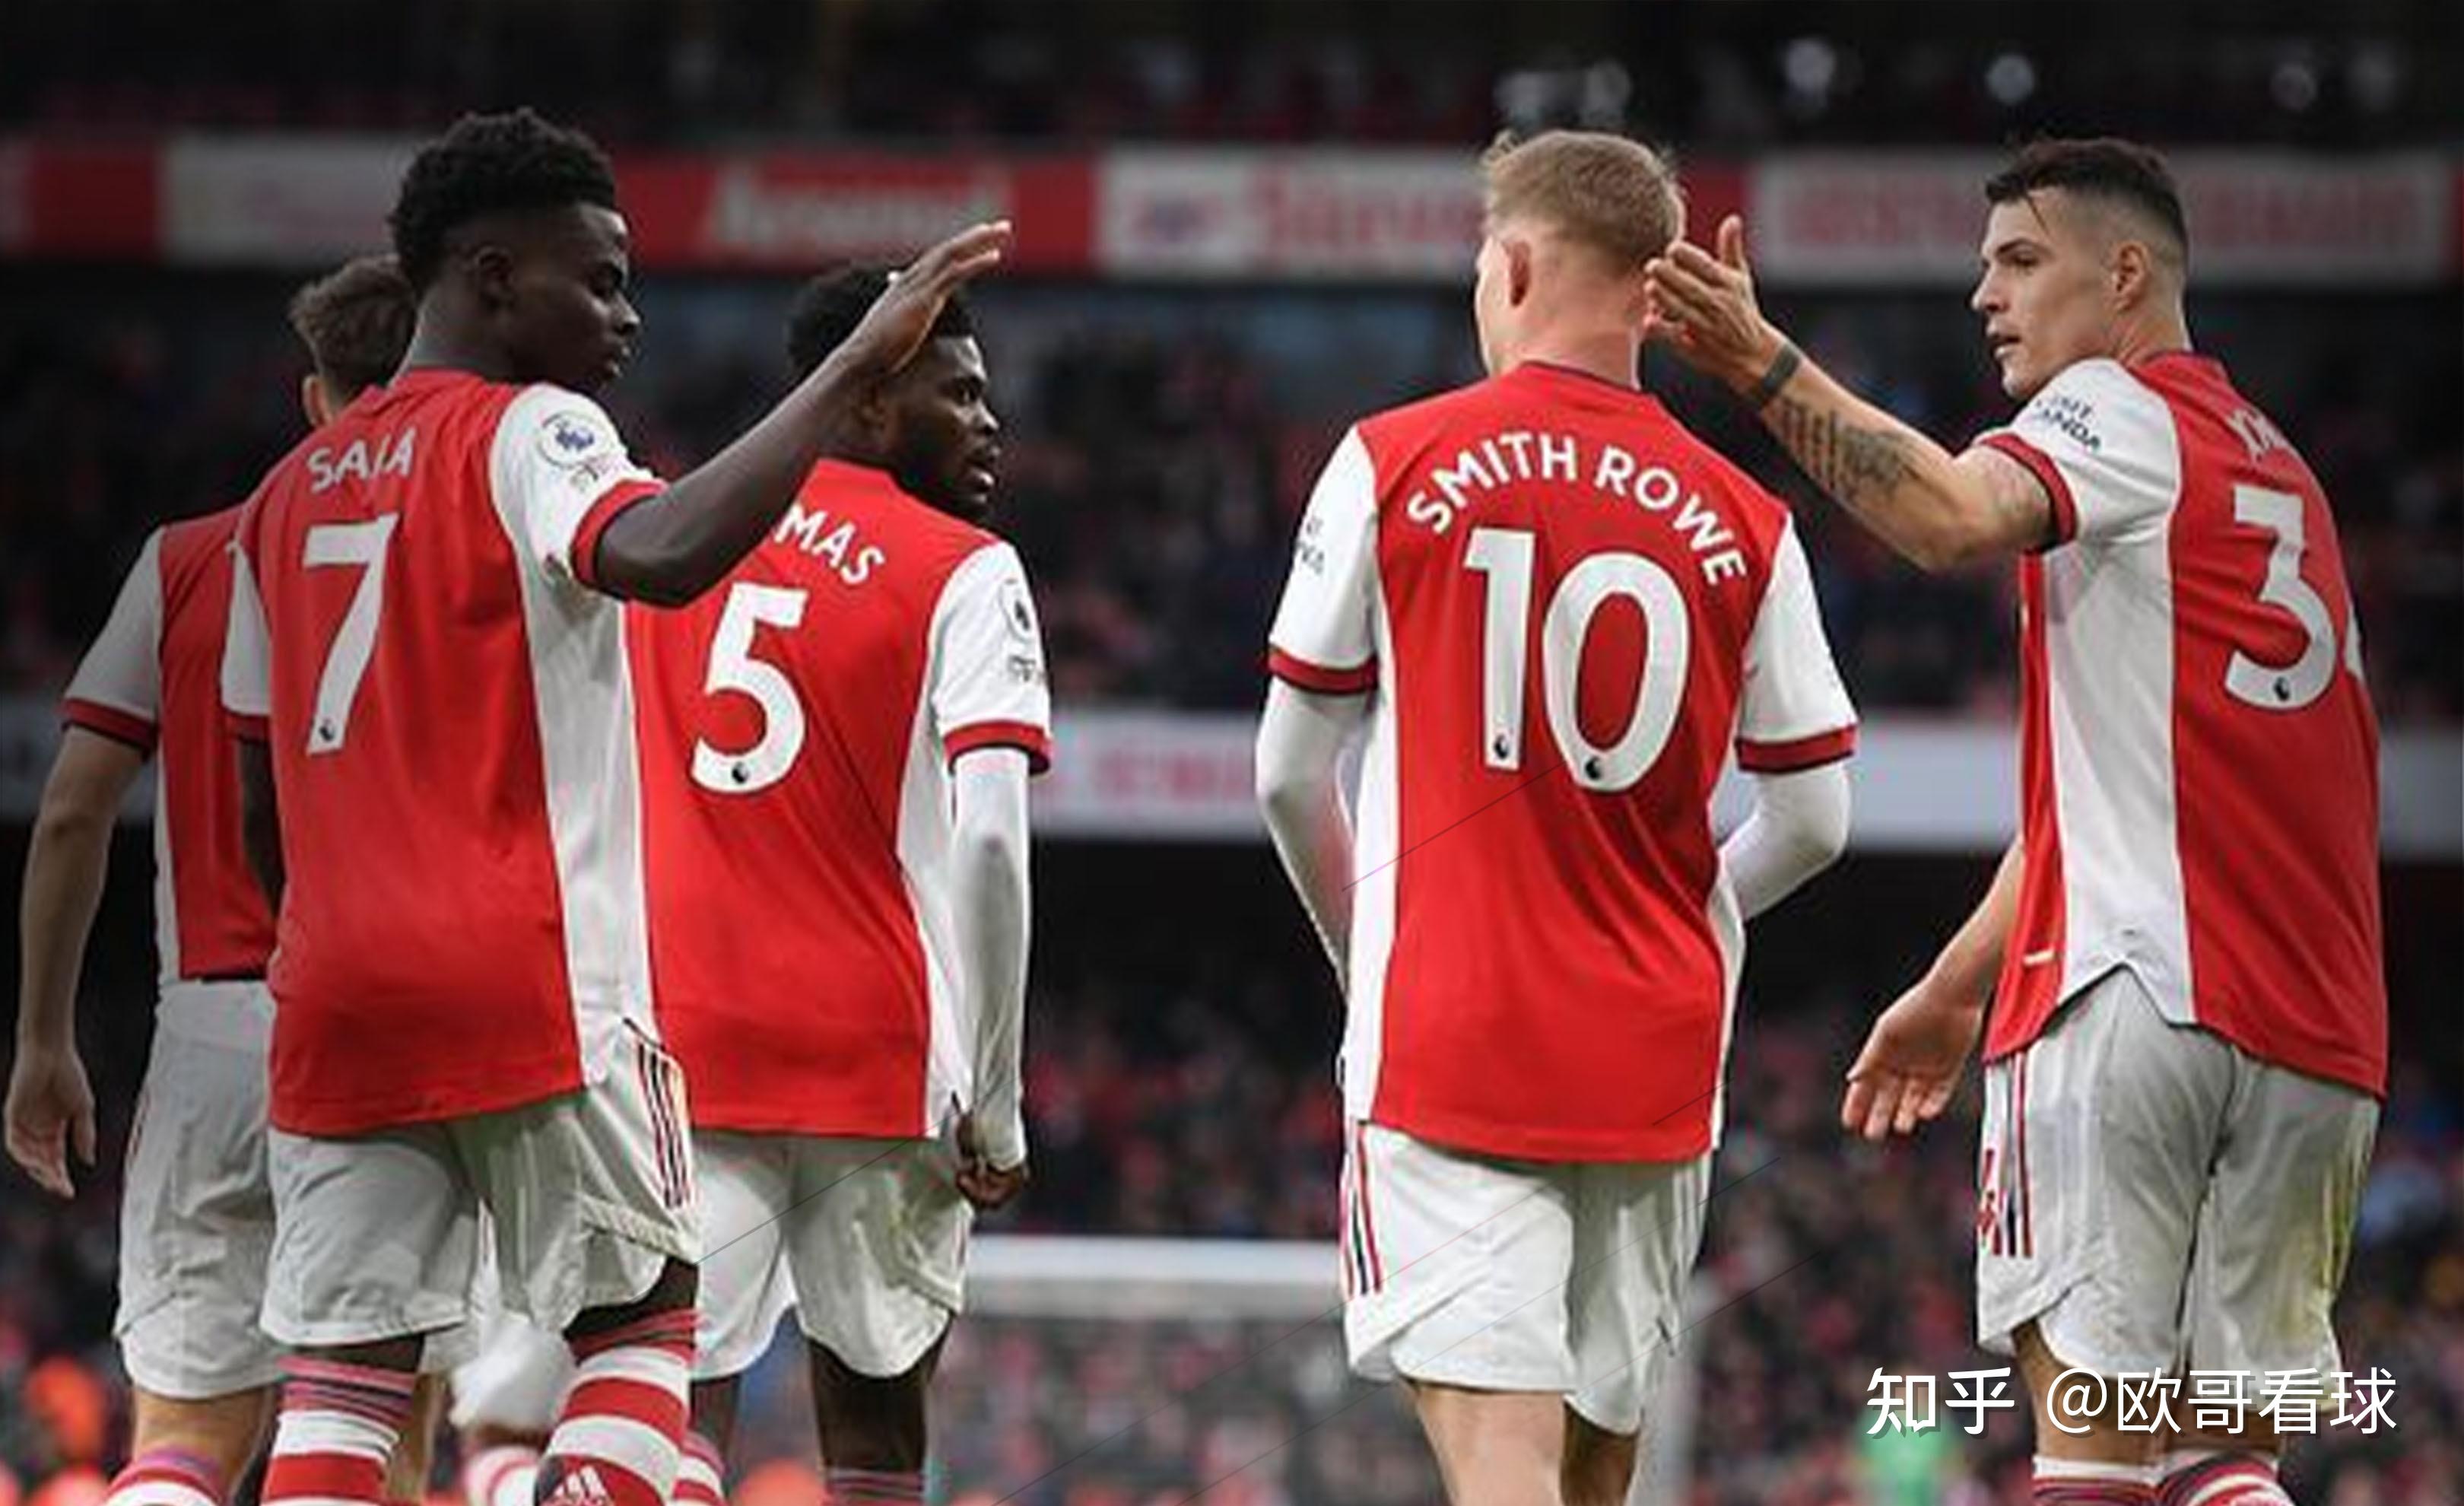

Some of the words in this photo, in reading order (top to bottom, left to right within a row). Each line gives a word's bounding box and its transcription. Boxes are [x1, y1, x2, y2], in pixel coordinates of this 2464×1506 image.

[773, 502, 886, 584] MAS
[1406, 431, 1578, 535] SMITH
[1594, 445, 1747, 586] ROWE
[302, 513, 399, 755] 7
[690, 581, 808, 795] 5
[1463, 526, 1692, 793] 10
